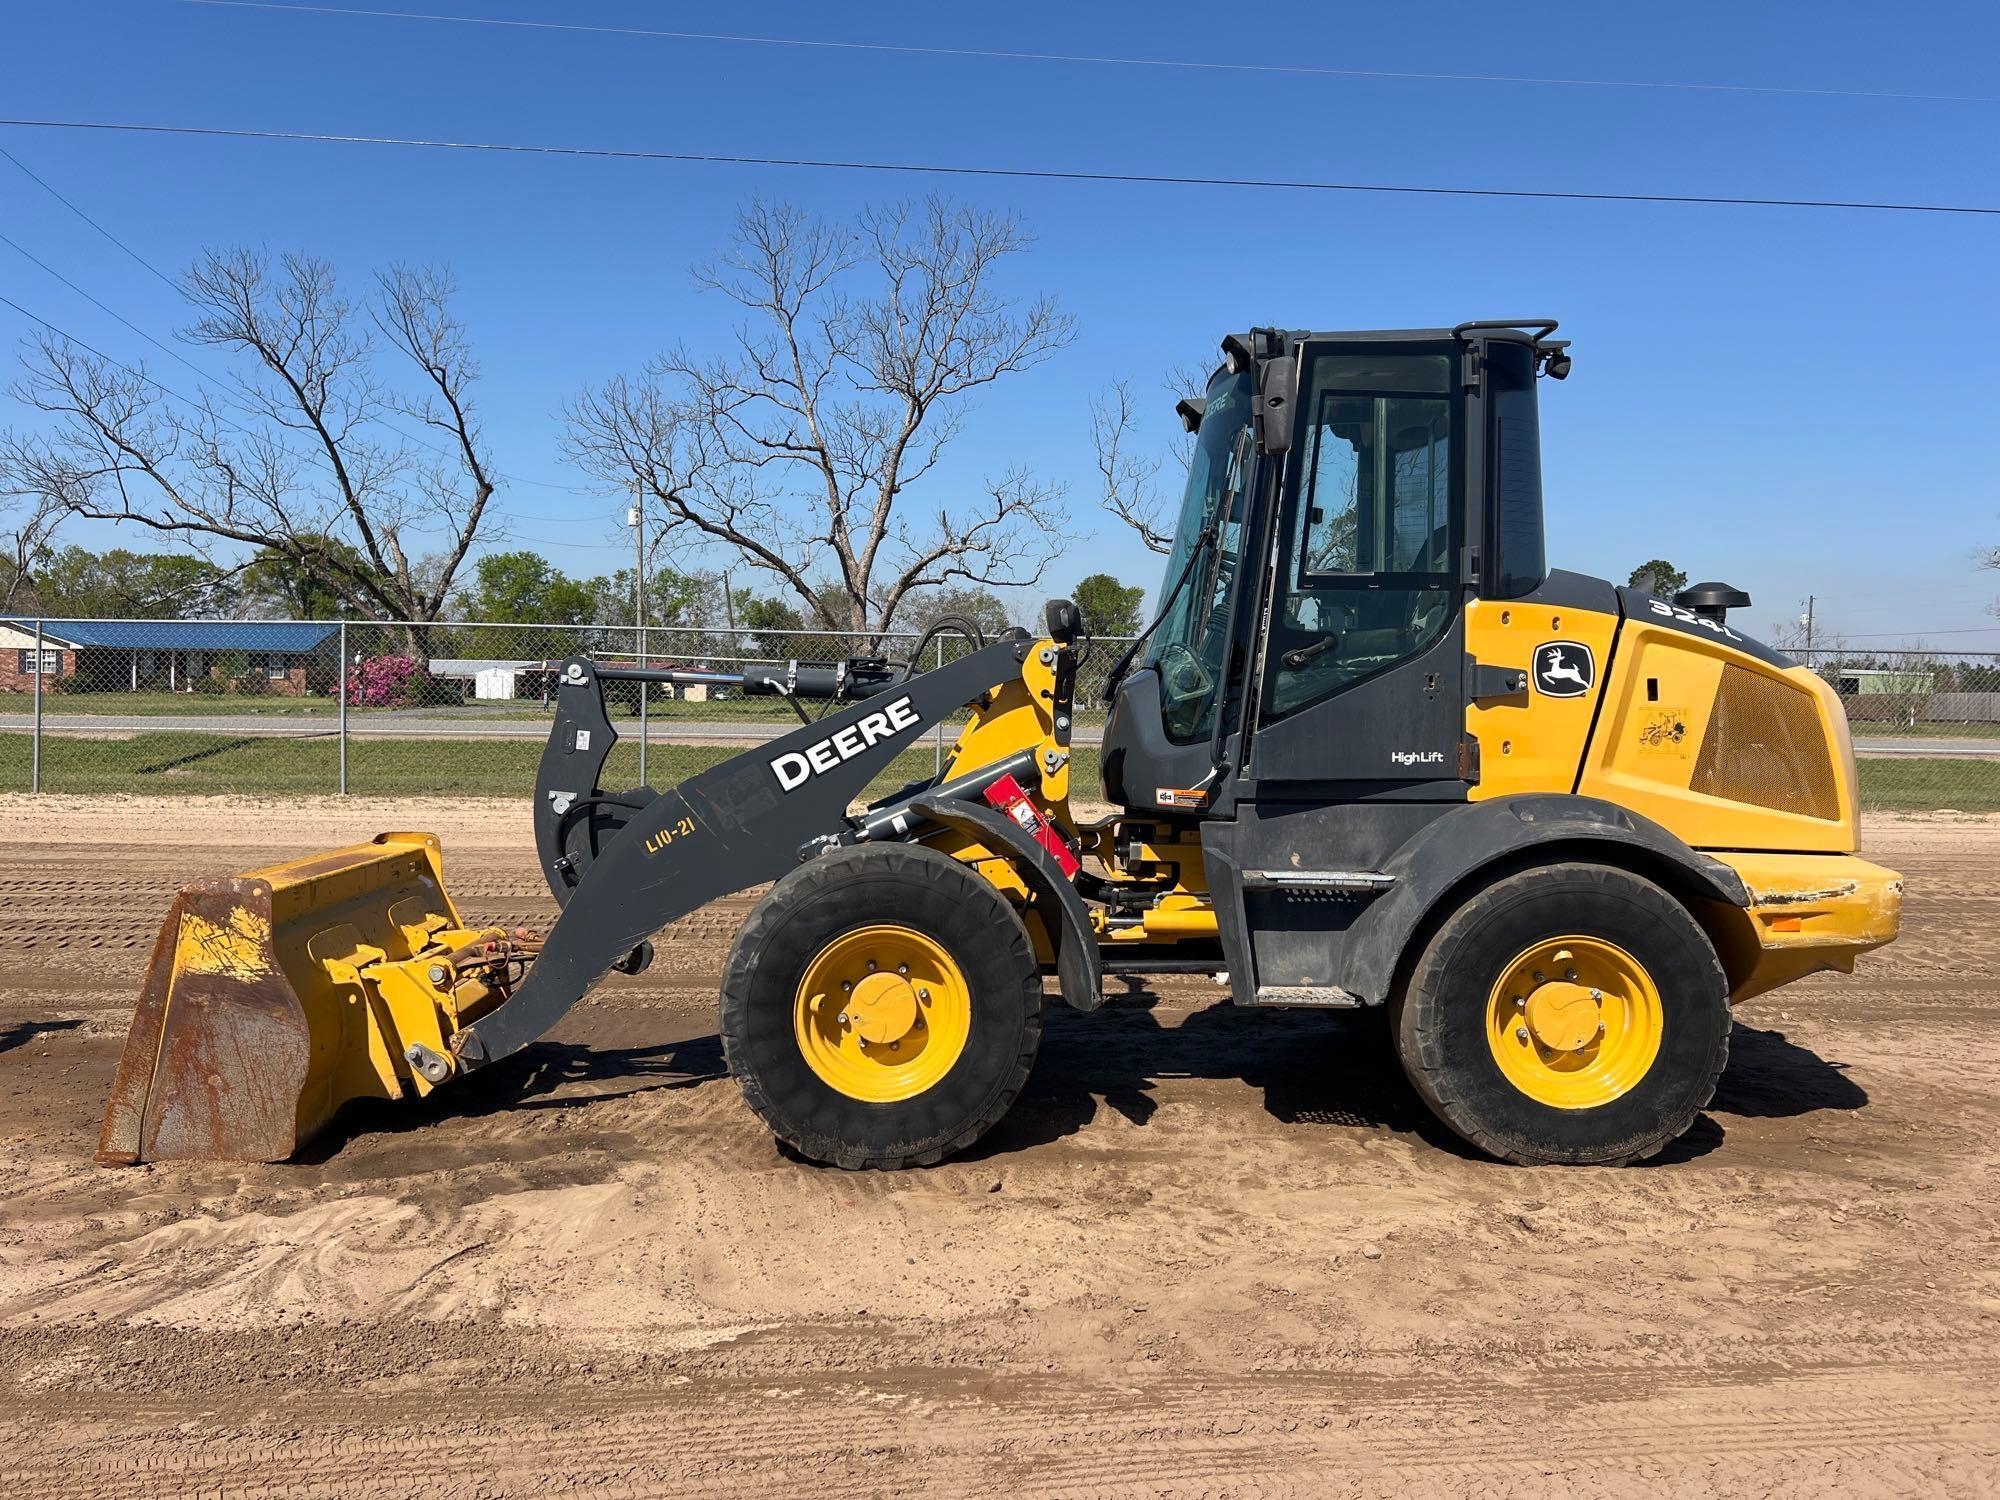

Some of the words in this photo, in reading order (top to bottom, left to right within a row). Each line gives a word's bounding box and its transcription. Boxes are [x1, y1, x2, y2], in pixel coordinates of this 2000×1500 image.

[1648, 599, 1743, 642] 324L
[770, 696, 920, 792] DEERE
[645, 817, 696, 853] L10-21
